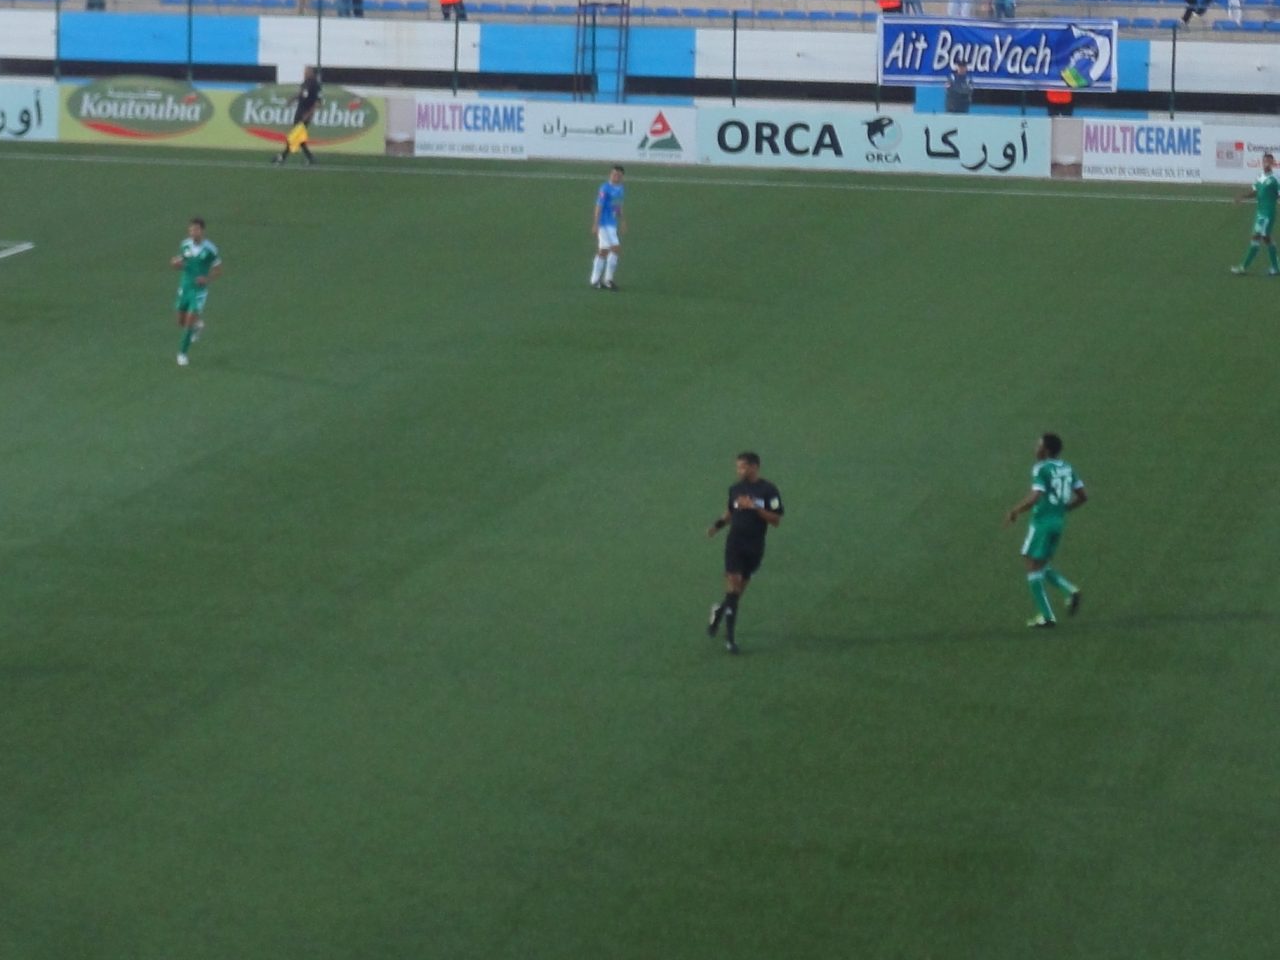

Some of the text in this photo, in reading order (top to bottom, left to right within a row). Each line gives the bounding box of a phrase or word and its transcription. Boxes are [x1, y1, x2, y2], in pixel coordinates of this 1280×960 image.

[885, 30, 1052, 75] Ait BouaYach
[81, 93, 202, 122] Koutoubia
[243, 97, 365, 128] Kouubia
[417, 104, 525, 134] MULTICERAME
[717, 120, 843, 157] ORCA
[924, 121, 1029, 172] أوركا
[1084, 124, 1202, 156] MULTICERAME
[866, 152, 902, 164] ORCA
